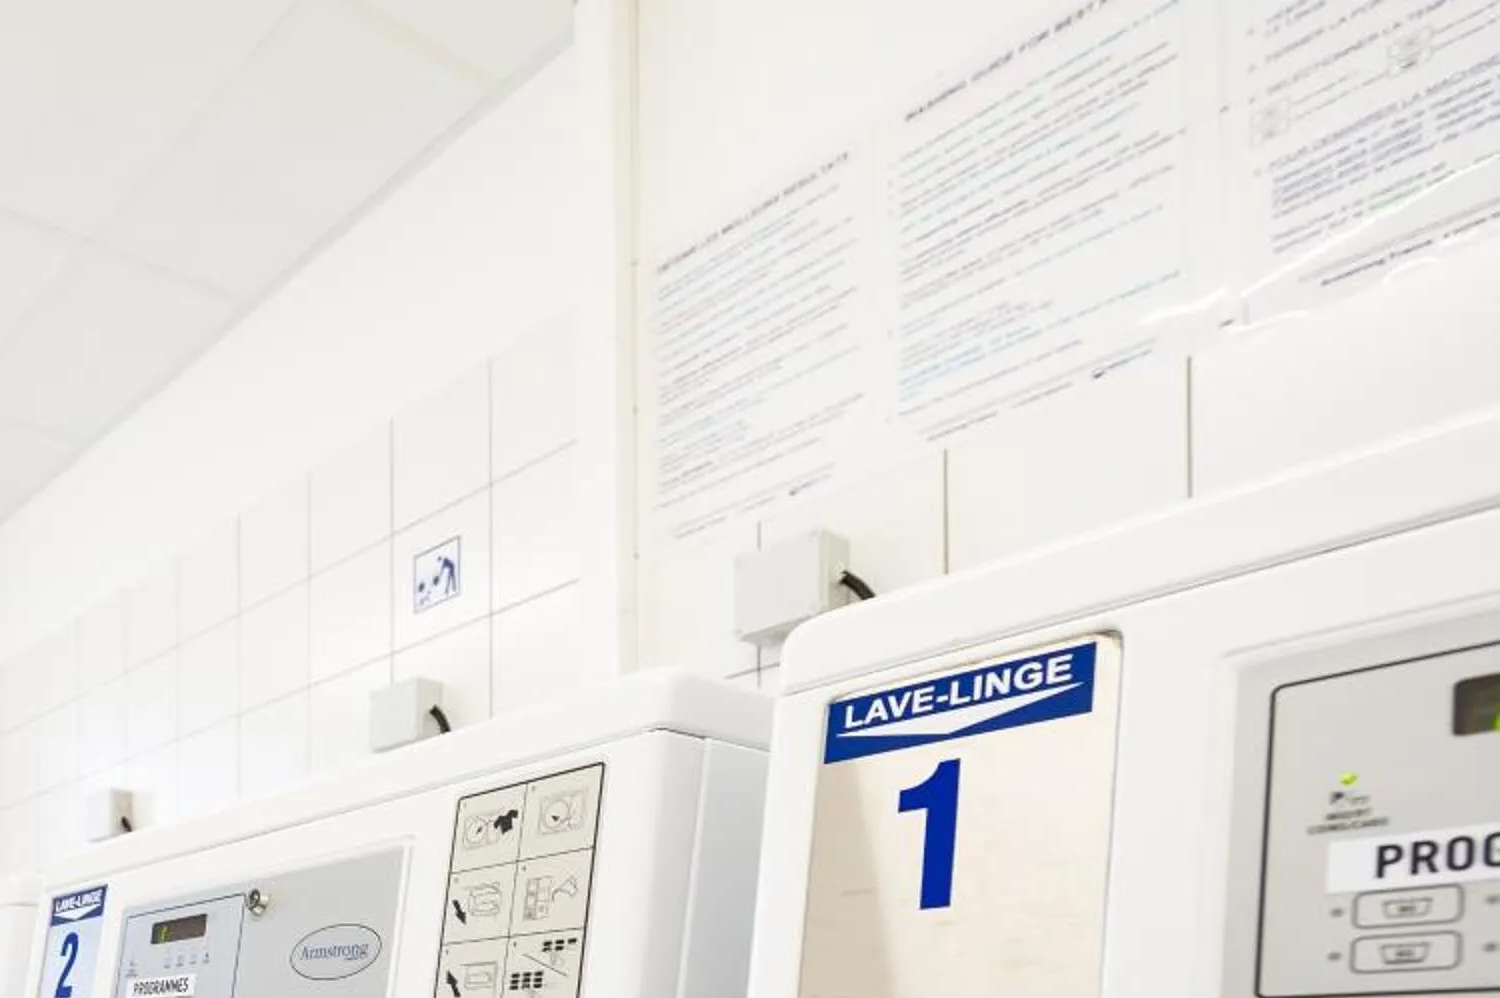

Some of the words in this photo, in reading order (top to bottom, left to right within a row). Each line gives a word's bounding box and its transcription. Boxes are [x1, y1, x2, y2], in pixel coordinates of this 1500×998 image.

[844, 653, 1074, 729] LAVE-LINGE
[897, 757, 961, 910] 1
[300, 943, 370, 961] Armstrong
